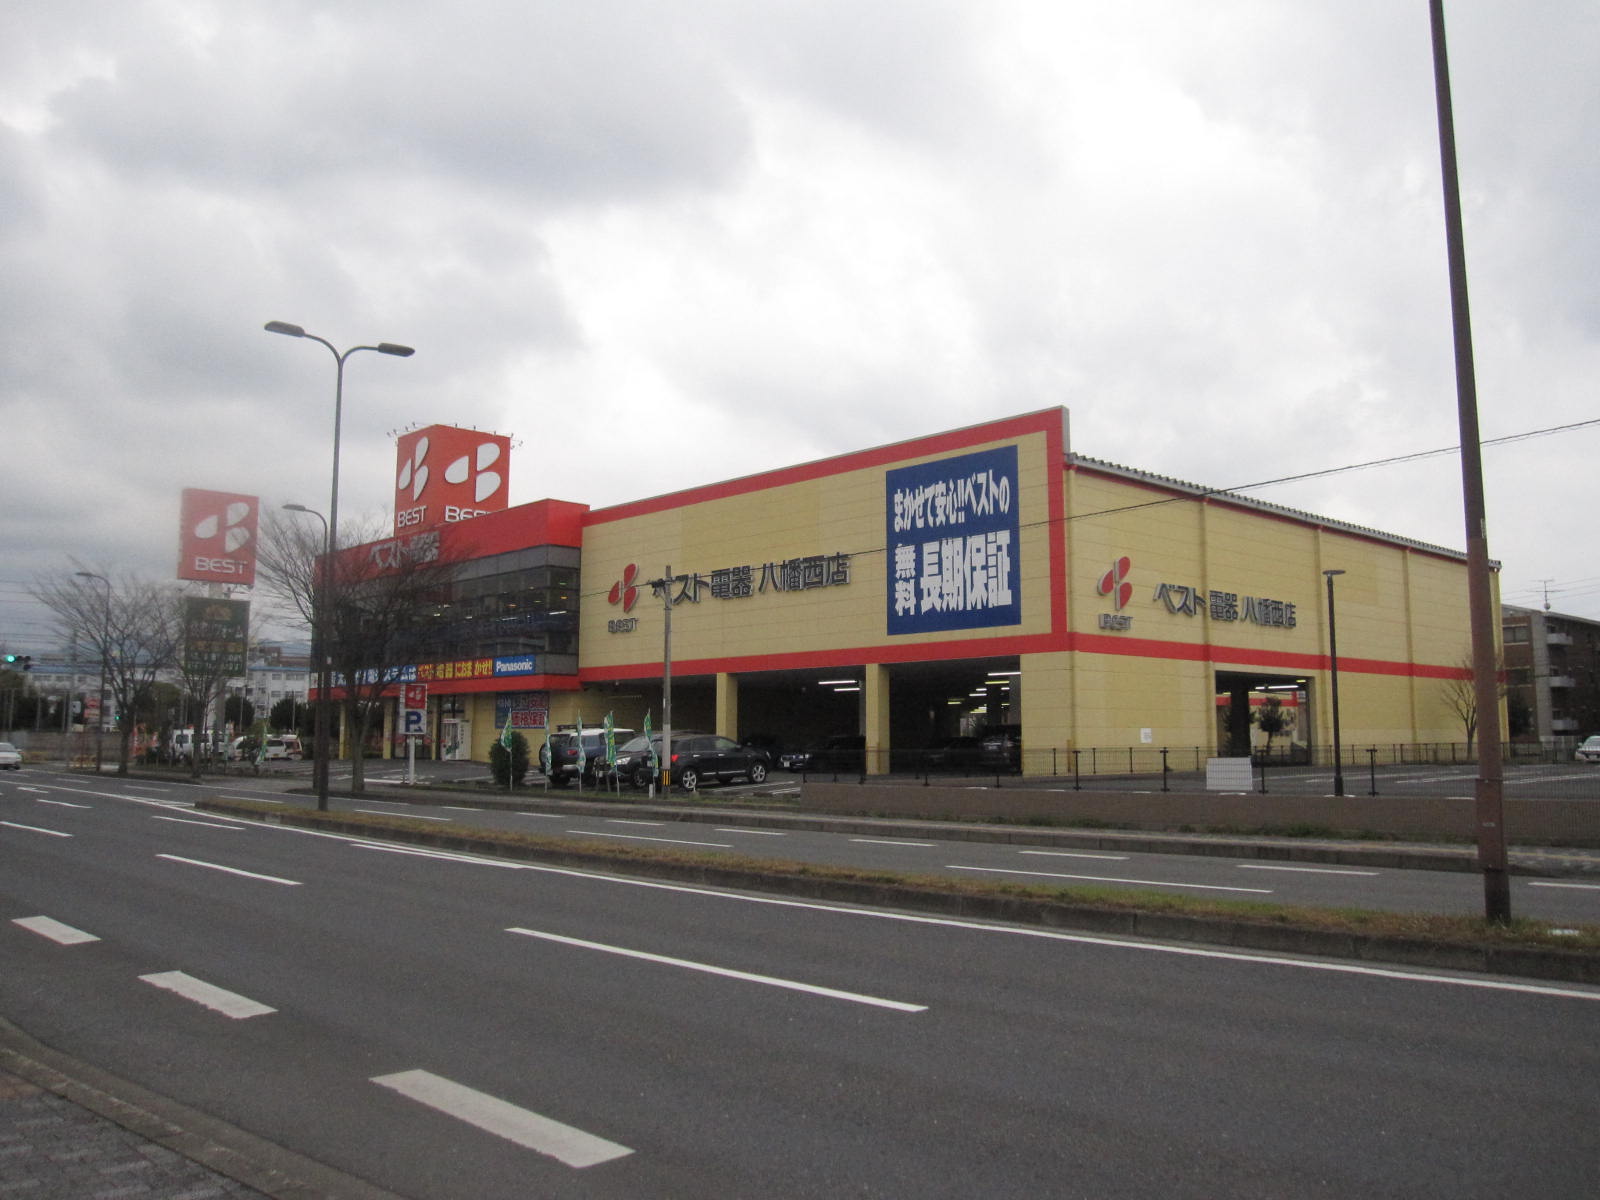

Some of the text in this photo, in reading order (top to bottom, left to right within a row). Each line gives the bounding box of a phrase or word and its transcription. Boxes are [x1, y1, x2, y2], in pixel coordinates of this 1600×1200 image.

[893, 469, 1010, 533] まかせて安心!!ベストの
[397, 505, 427, 528] BEST
[444, 505, 492, 523] BE
[195, 556, 249, 575] BEST
[920, 529, 1013, 616] 長期保証
[894, 543, 917, 617] 無料
[495, 658, 533, 673] Panasonic
[405, 711, 422, 733] P
